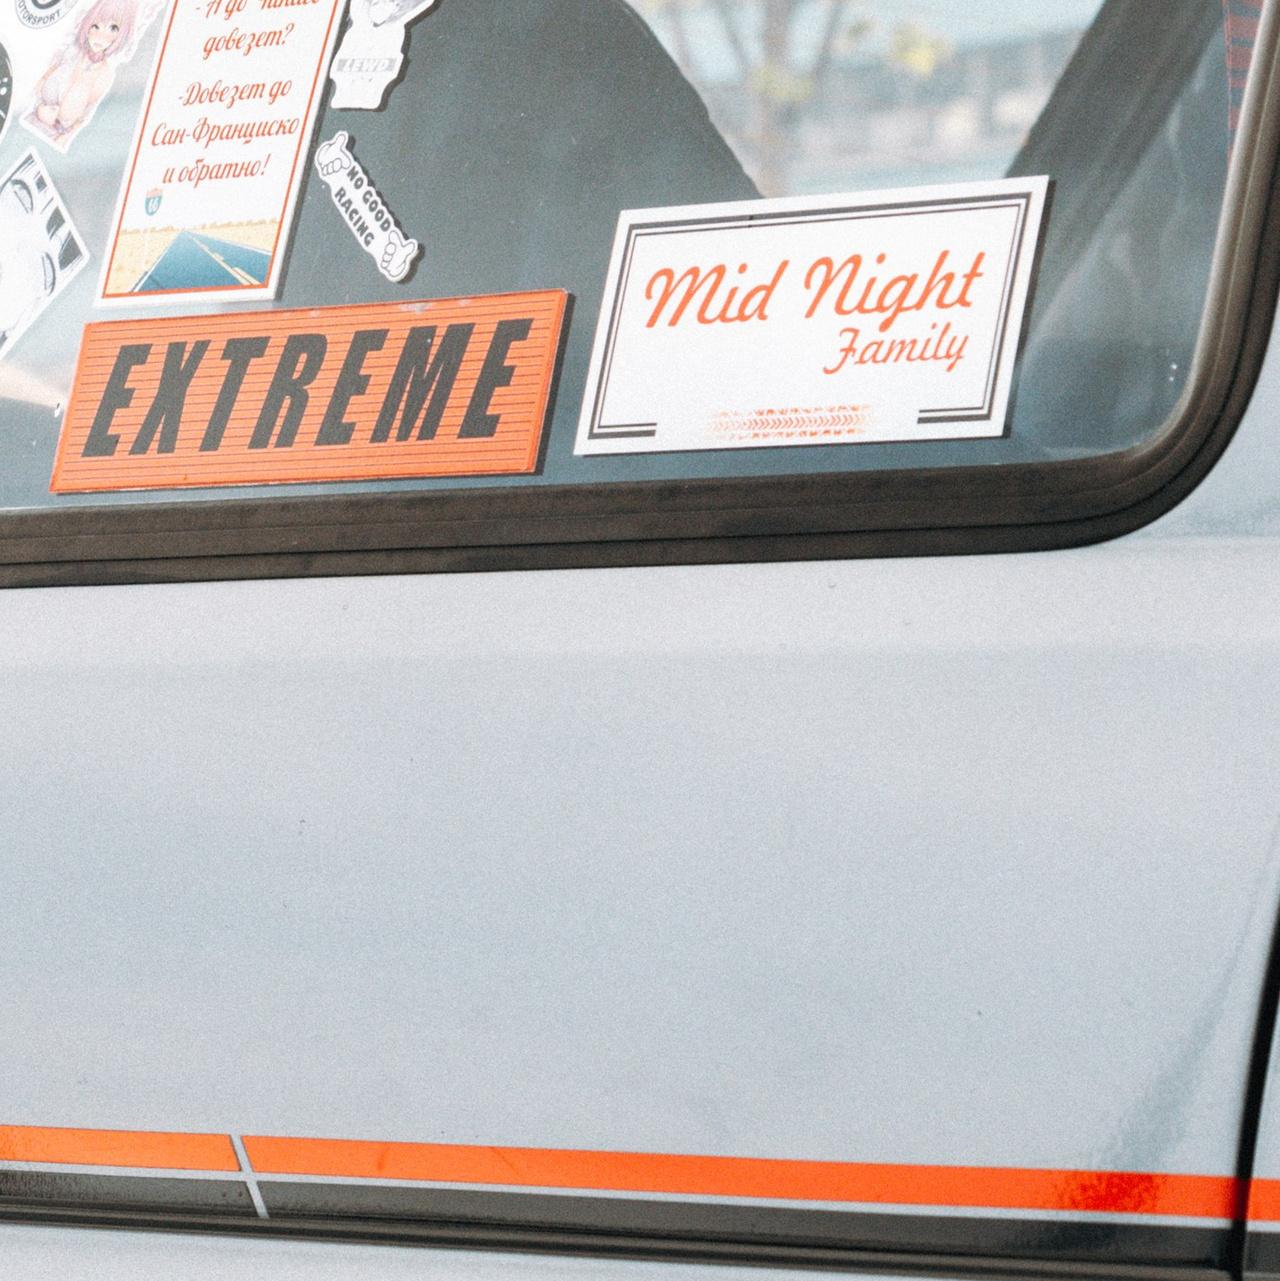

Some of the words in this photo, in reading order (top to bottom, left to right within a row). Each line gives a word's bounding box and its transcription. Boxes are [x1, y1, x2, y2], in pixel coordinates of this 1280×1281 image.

[202, 22, 295, 61] довезет?
[268, 79, 293, 106] до
[151, 116, 300, 150] Сан-Франциско
[161, 167, 176, 184] и
[177, 153, 272, 189] обратно!
[346, 164, 365, 190] NO
[362, 189, 391, 233] GOOD
[334, 186, 375, 248] RACING
[644, 258, 790, 329] Mid
[803, 249, 987, 333] Night
[822, 320, 971, 376] Family
[80, 318, 535, 458] EXTREME
